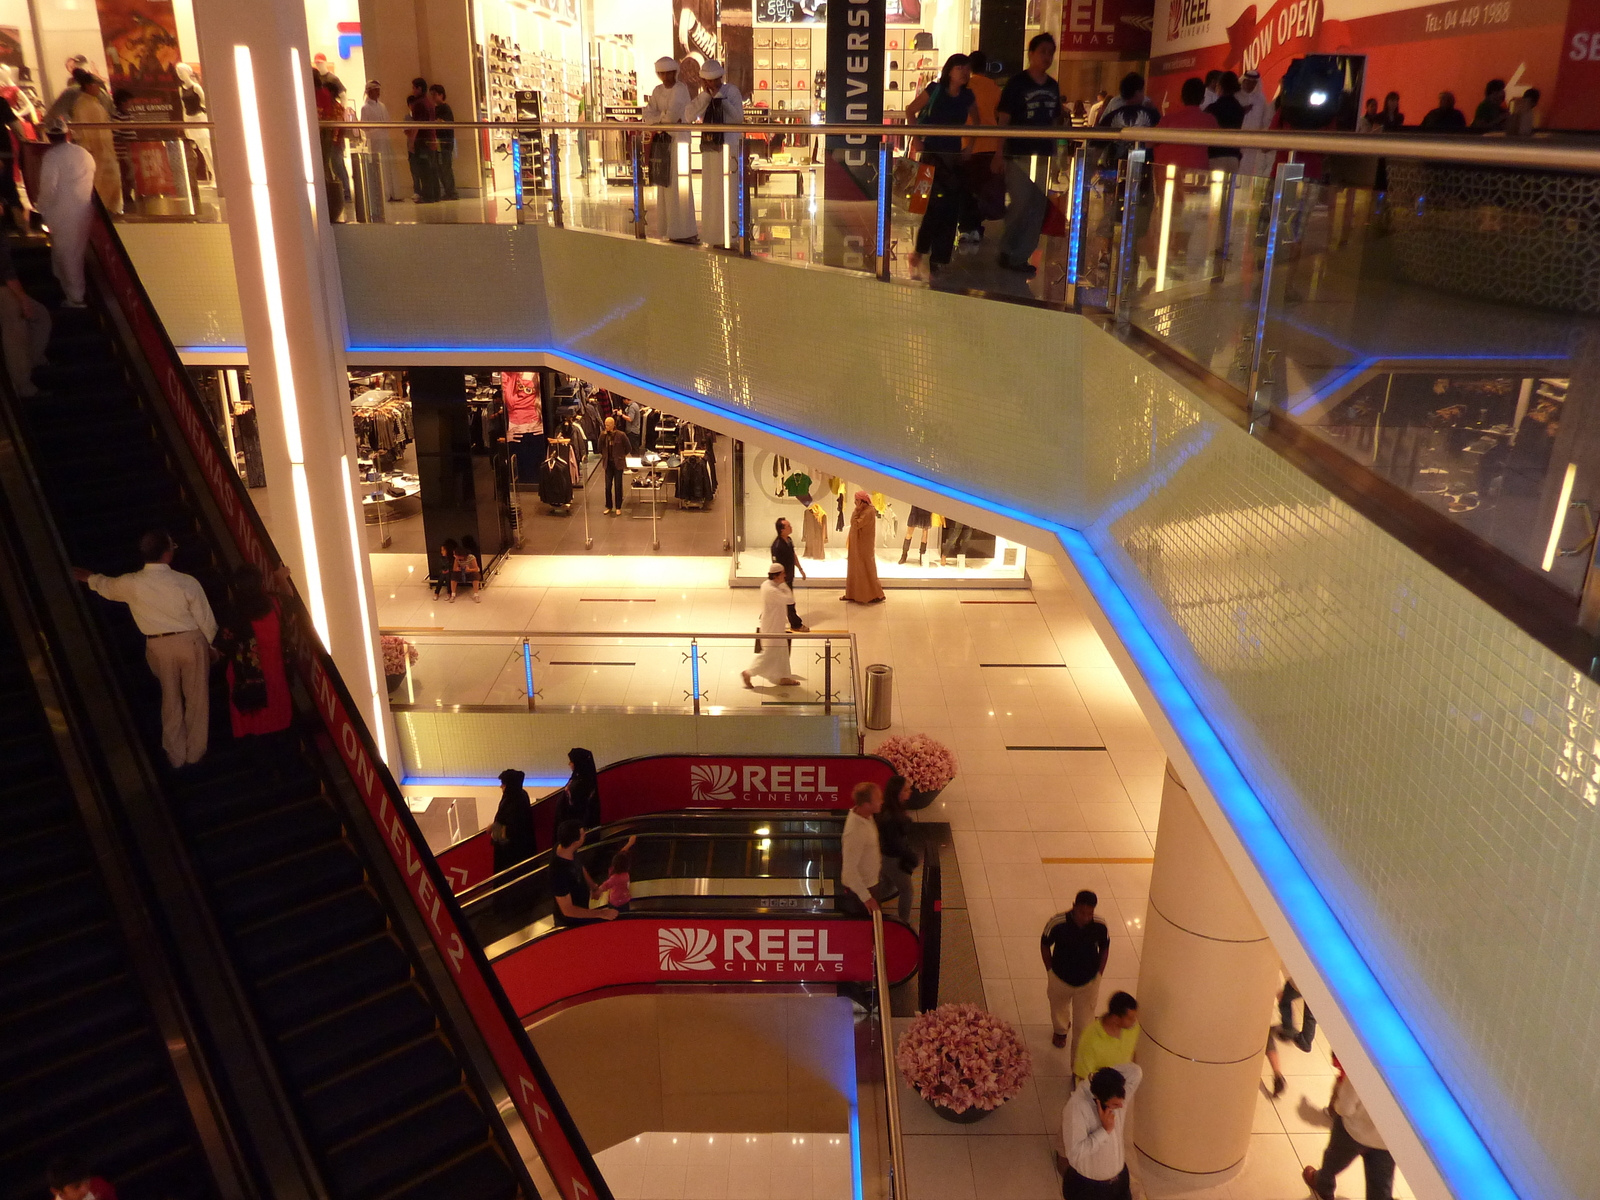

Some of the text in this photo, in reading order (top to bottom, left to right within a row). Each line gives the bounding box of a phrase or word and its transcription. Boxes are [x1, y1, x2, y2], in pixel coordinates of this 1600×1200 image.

[1425, 13, 1443, 33] TEL:
[1444, 9, 1459, 31] 04
[1459, 6, 1481, 28] 449
[1242, 0, 1319, 74] NOW OPEN
[844, 0, 870, 167] CONVERS
[166, 366, 235, 517] CINEMAS
[342, 721, 375, 797] ON
[378, 793, 443, 936] LEVEL
[446, 932, 466, 974] 2
[742, 765, 839, 793] REEL
[743, 793, 839, 802] CINEMAS
[723, 928, 844, 962] REEL
[723, 961, 844, 973] CINEMAS
